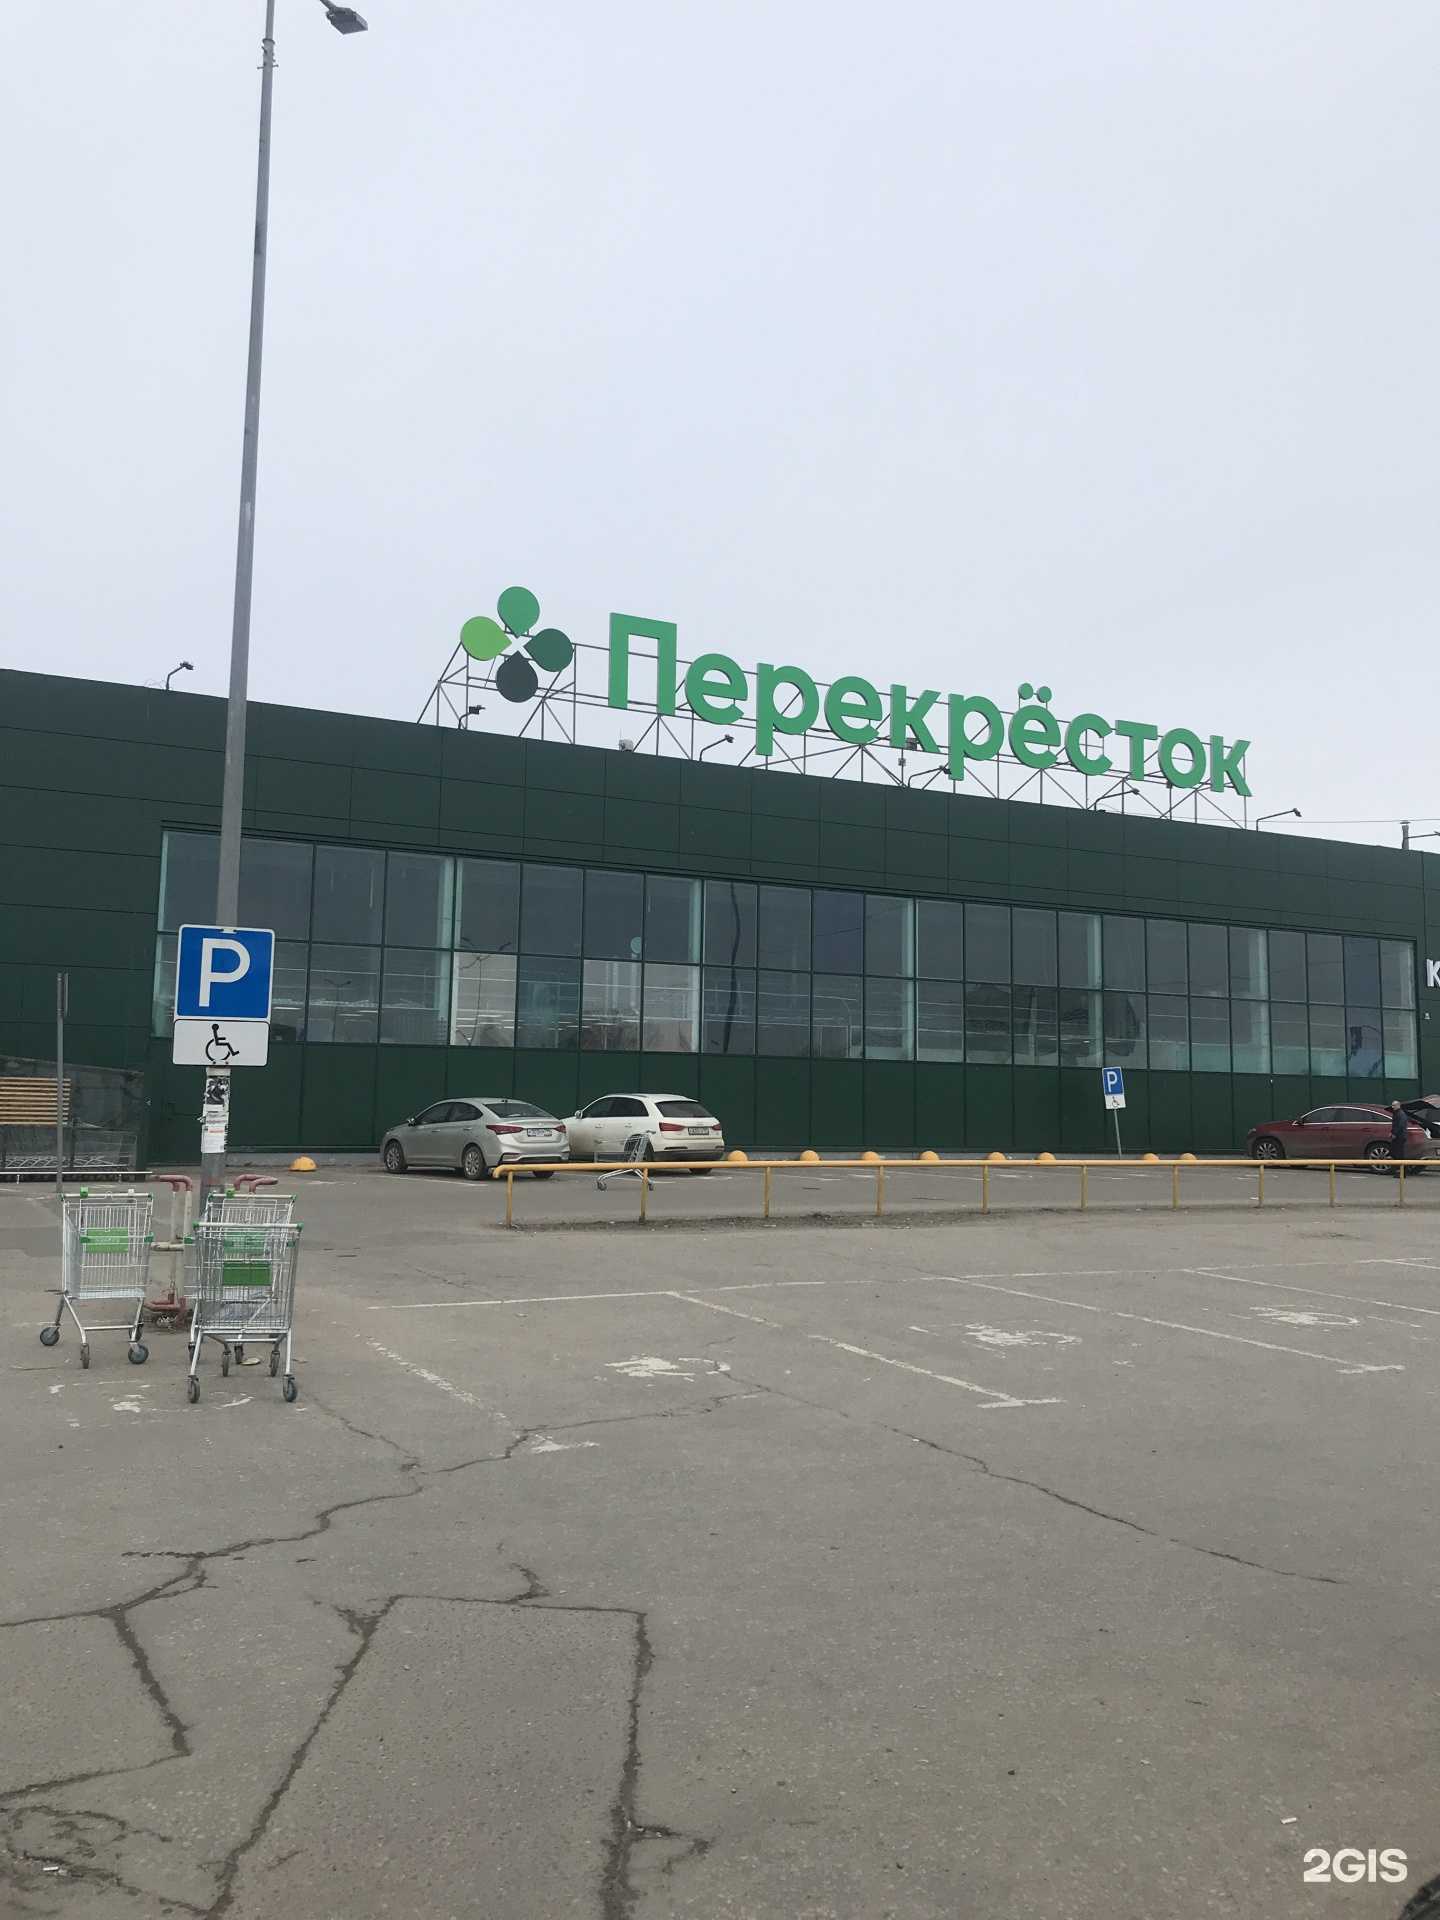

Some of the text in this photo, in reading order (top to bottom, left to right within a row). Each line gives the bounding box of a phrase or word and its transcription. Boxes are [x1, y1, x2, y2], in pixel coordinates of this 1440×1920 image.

[608, 612, 1252, 797] Перекрёсток
[199, 938, 250, 1007] P
[1107, 1071, 1118, 1093] P
